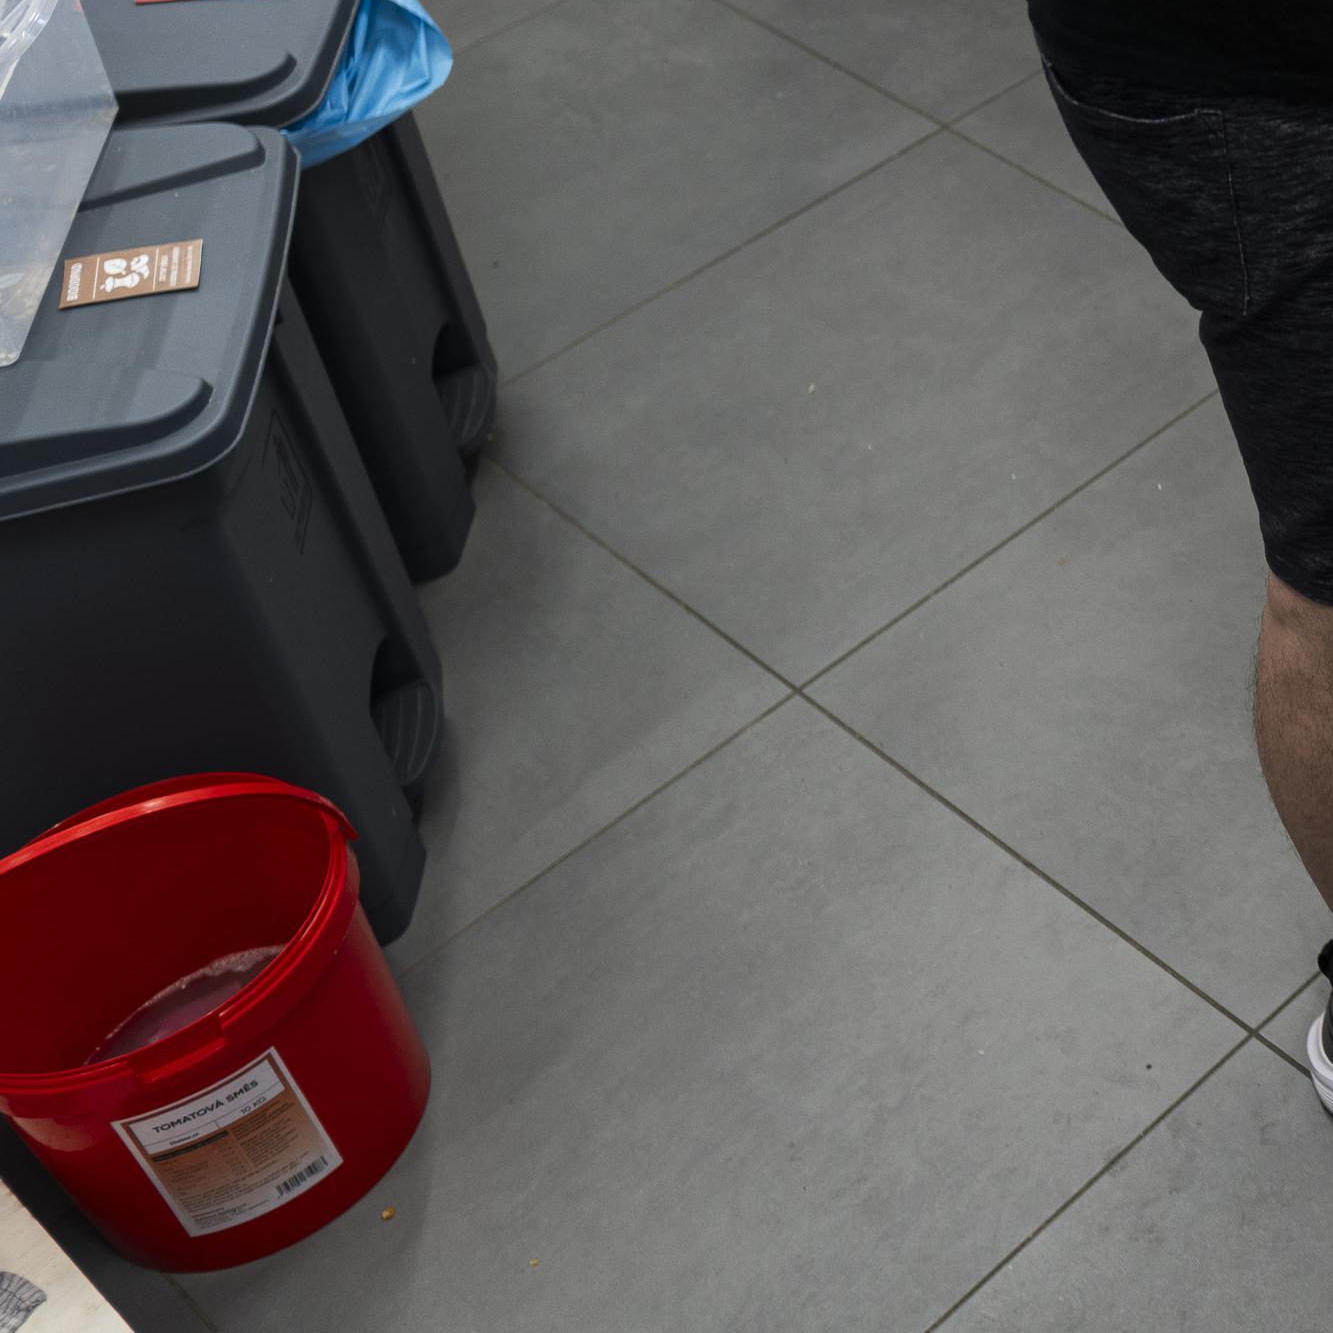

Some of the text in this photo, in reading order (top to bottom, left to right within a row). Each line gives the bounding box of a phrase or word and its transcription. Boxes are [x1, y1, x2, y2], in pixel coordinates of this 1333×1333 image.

[152, 1079, 259, 1134] TOMATOVÁ SMĚS
[240, 1105, 250, 1115] 10
